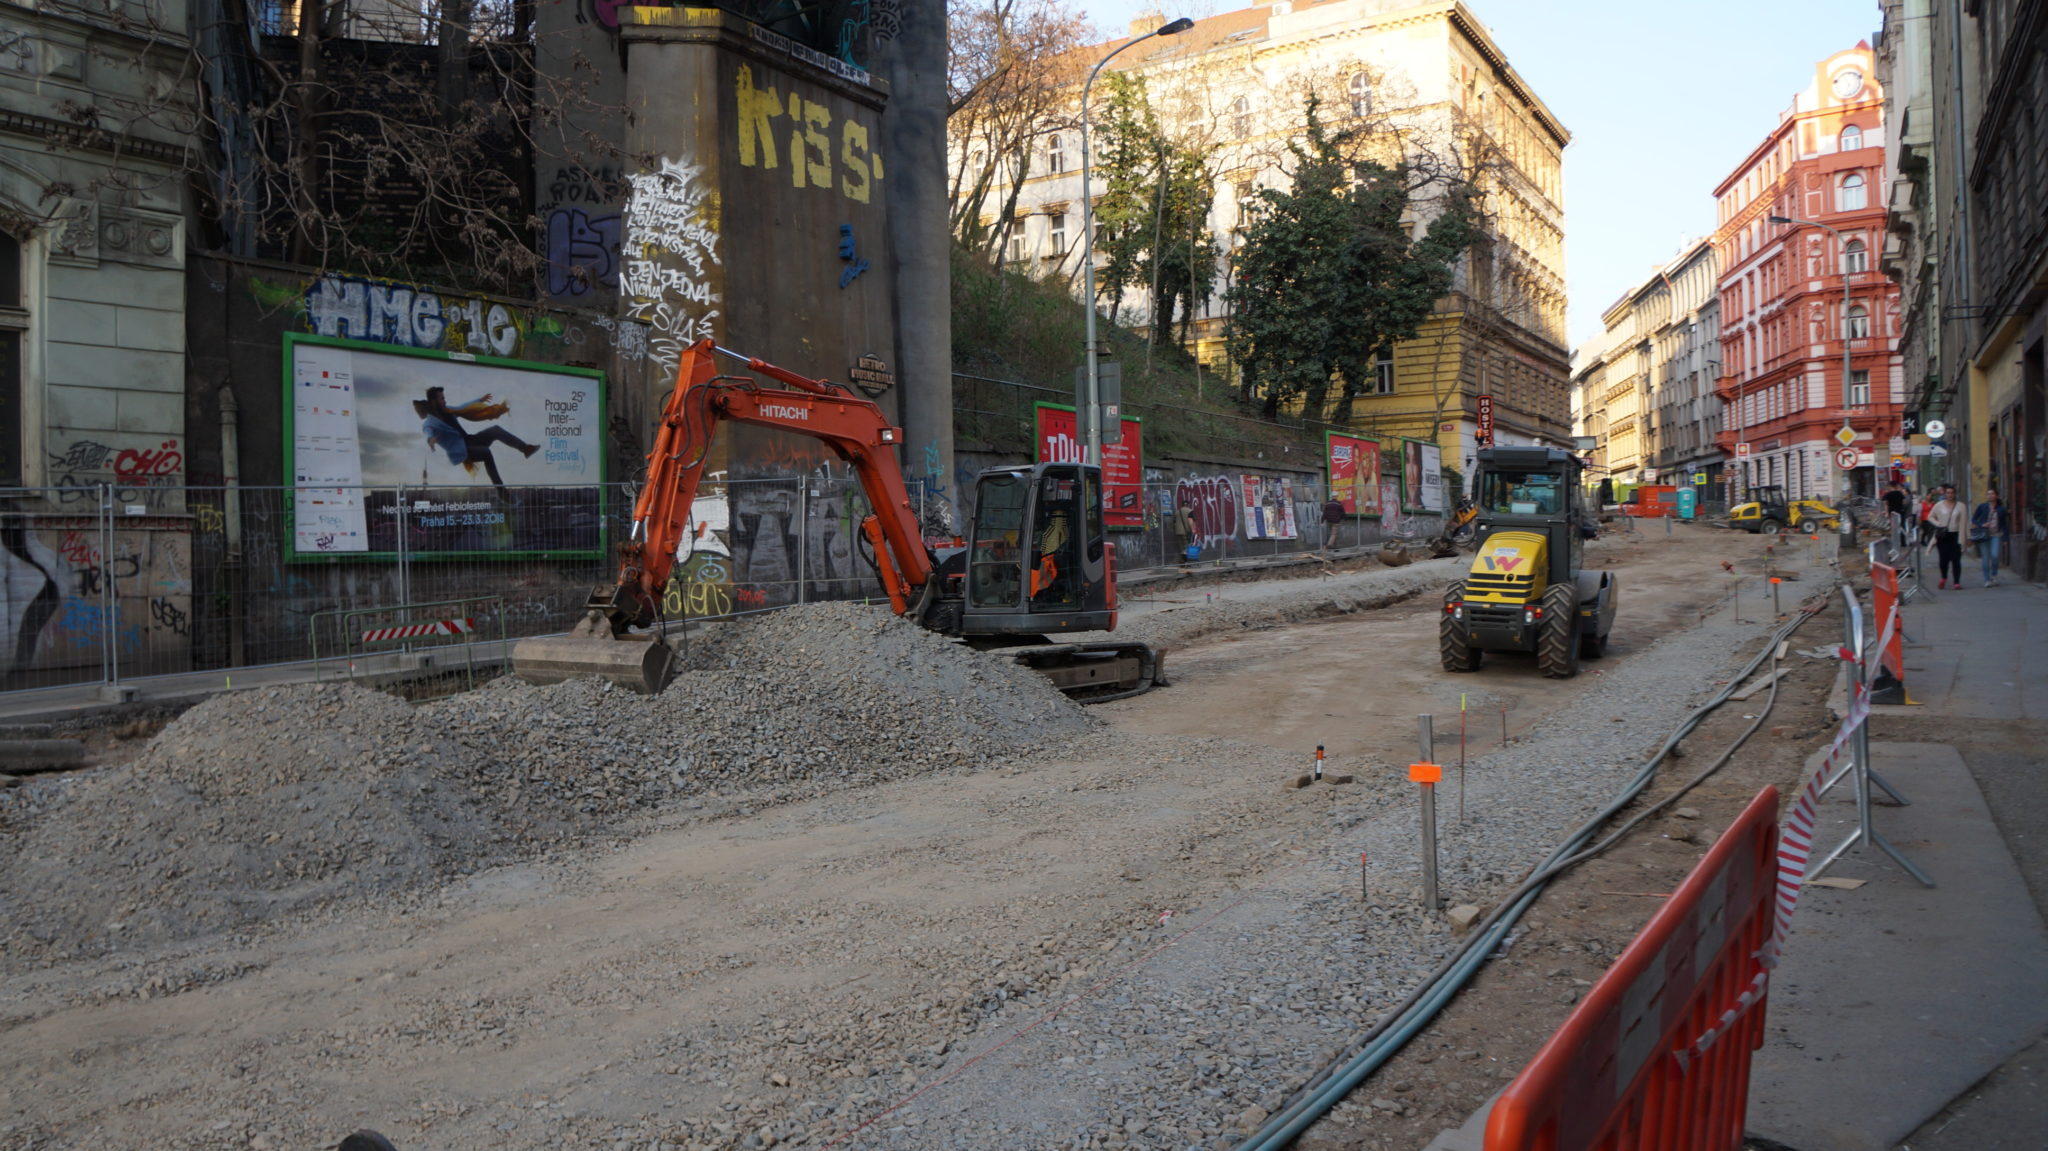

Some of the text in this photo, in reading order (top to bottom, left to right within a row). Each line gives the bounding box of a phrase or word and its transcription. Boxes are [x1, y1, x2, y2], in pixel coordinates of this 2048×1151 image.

[545, 399, 578, 413] Prague
[760, 404, 808, 420] HITACHI
[545, 424, 582, 437] national
[550, 437, 568, 449] Film
[545, 449, 579, 462] Festival
[421, 516, 444, 527] Praha
